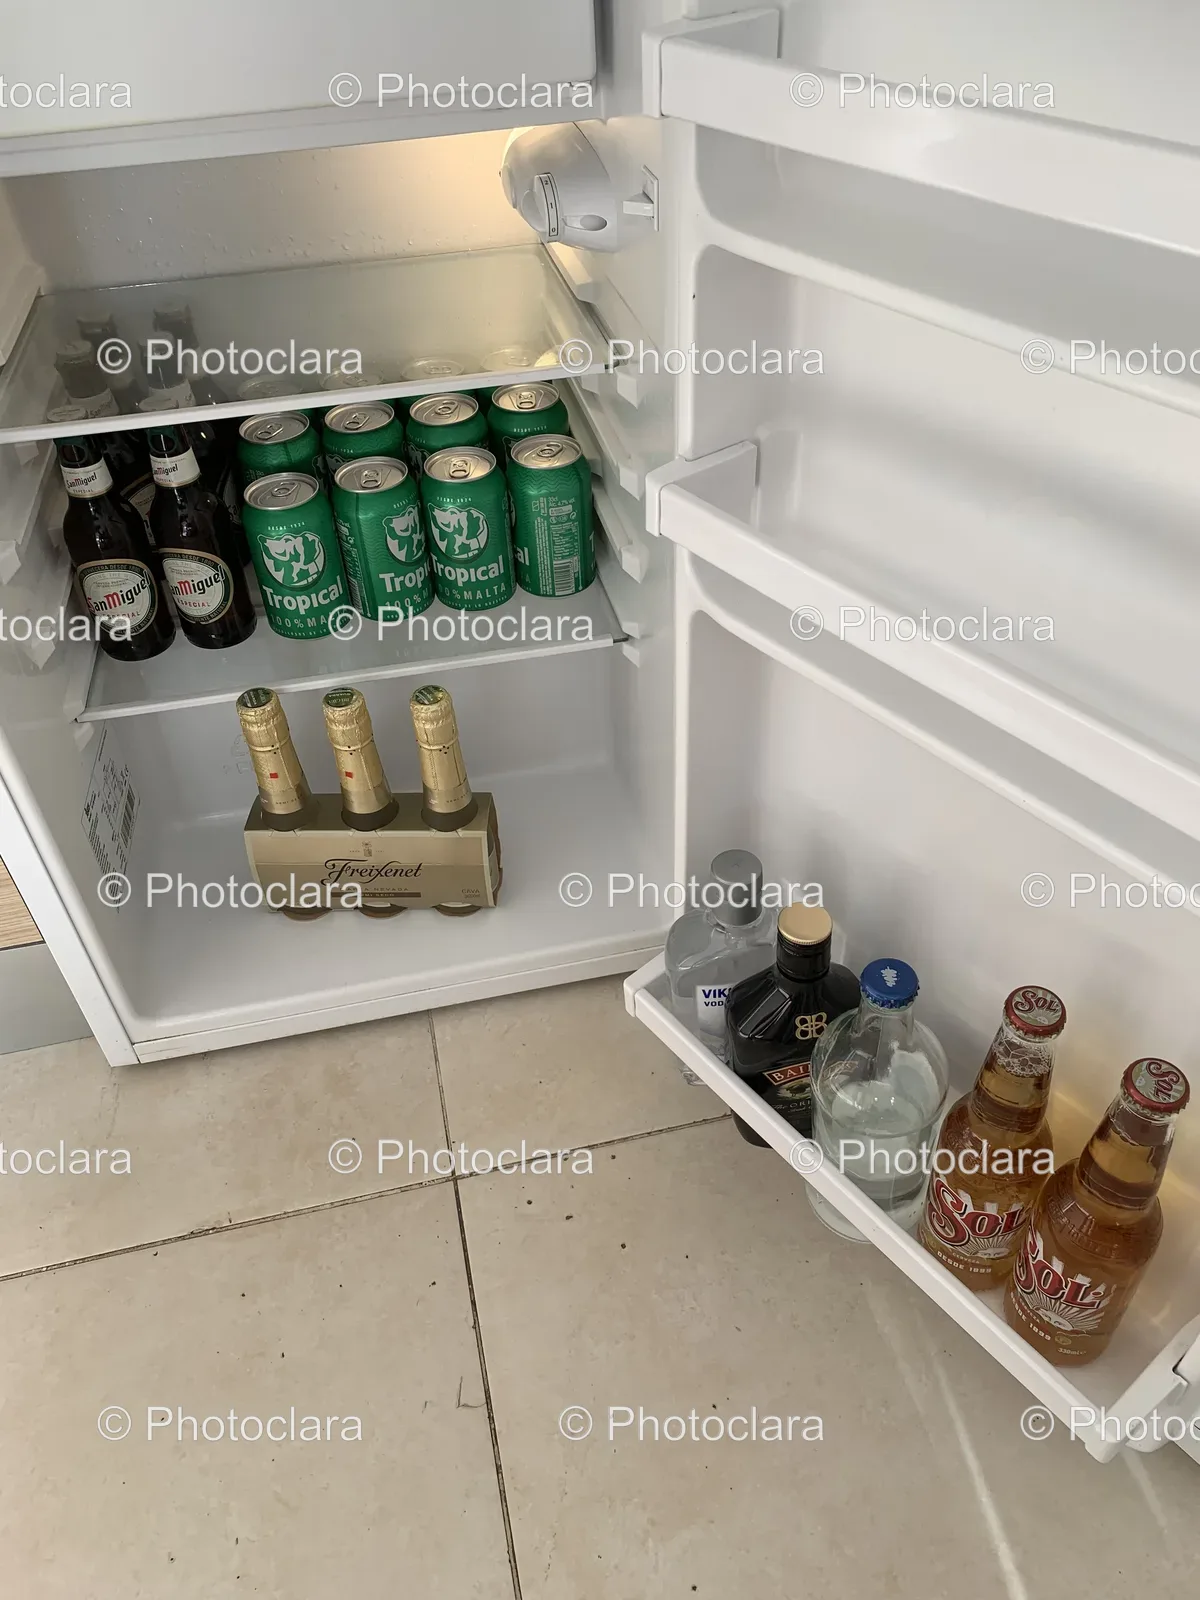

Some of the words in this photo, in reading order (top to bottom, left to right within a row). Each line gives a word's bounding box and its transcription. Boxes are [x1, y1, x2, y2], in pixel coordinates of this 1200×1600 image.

[431, 555, 504, 587] Tropical
[262, 575, 343, 615] Tropical
[320, 858, 424, 886] Freixenet
[702, 988, 731, 999] VIK
[937, 1250, 965, 1270] DESDE
